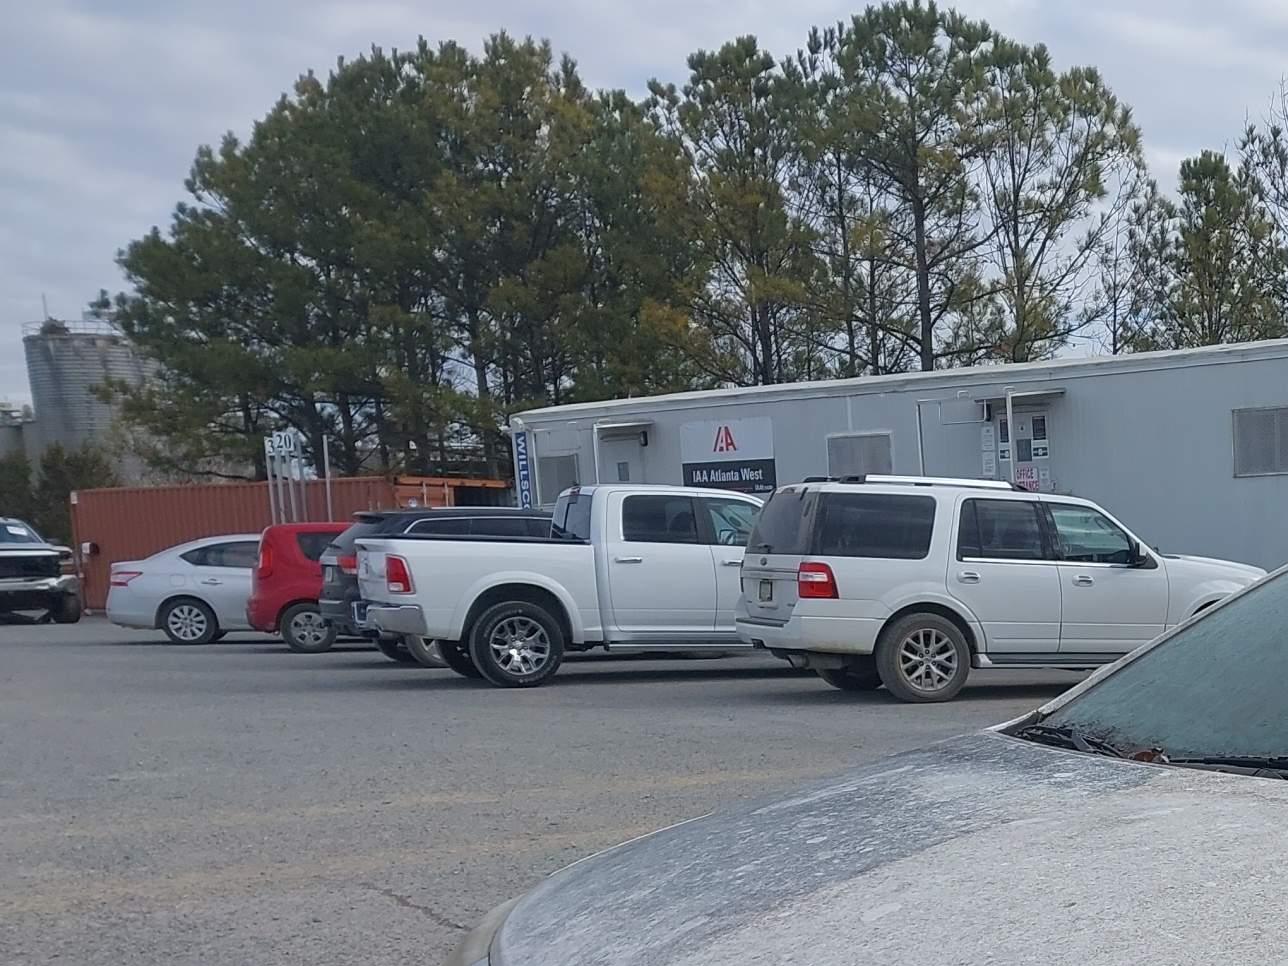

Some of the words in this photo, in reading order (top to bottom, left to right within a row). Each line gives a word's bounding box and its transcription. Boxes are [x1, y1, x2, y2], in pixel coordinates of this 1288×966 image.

[275, 434, 292, 449] 20
[692, 470, 709, 483] IAA
[710, 468, 739, 482] Atlanta
[740, 467, 763, 481] West
